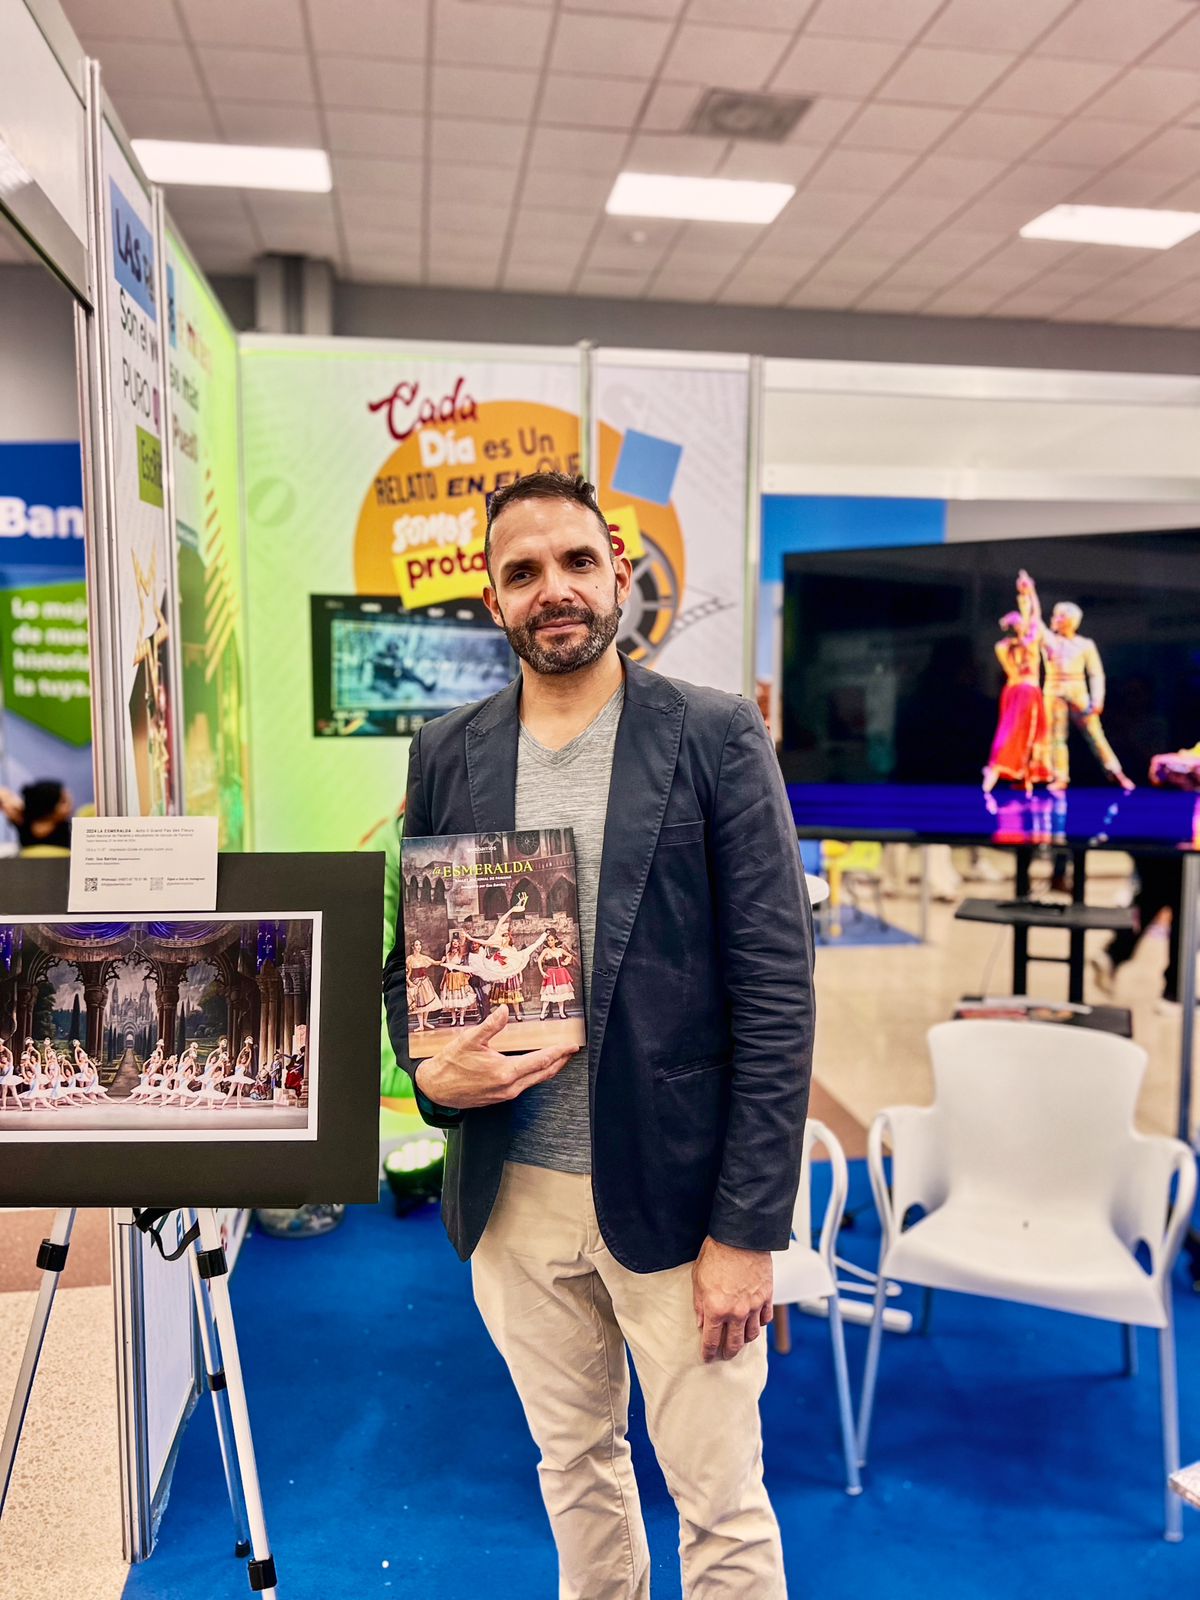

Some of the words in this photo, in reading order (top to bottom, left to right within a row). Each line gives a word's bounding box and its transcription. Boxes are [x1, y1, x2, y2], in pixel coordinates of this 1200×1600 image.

[114, 207, 142, 284] LAS
[121, 355, 151, 419] PURO
[367, 377, 477, 440] Cada
[483, 439, 512, 460] es
[517, 427, 554, 456] Un
[374, 470, 437, 505] RELATO
[447, 475, 484, 497] EN
[443, 860, 534, 878] ESMERALDA
